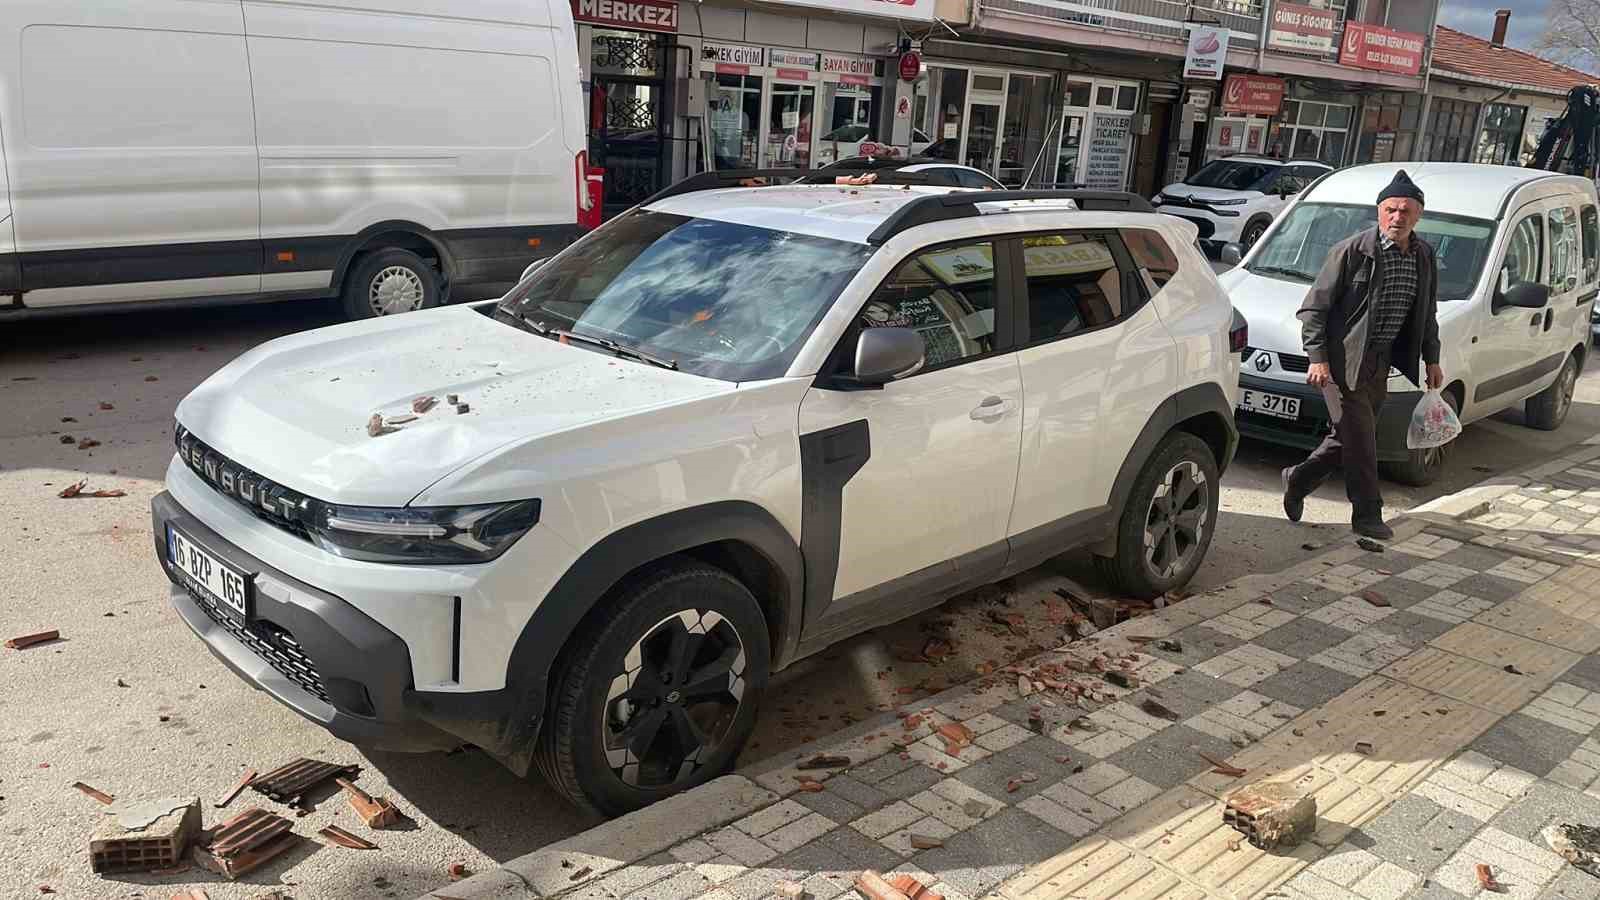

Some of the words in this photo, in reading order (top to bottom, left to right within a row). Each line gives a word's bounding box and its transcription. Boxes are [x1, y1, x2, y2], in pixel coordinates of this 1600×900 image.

[578, 0, 677, 27] MERKEZİ
[1275, 7, 1300, 28] GÜNEŞ
[1301, 12, 1333, 31] SİGORTA
[824, 58, 848, 71] BAYAN
[1262, 395, 1297, 413] 3716
[180, 442, 296, 520] RENAULT
[173, 533, 185, 563] 16
[190, 545, 212, 586] BZP
[220, 567, 244, 611] 165
